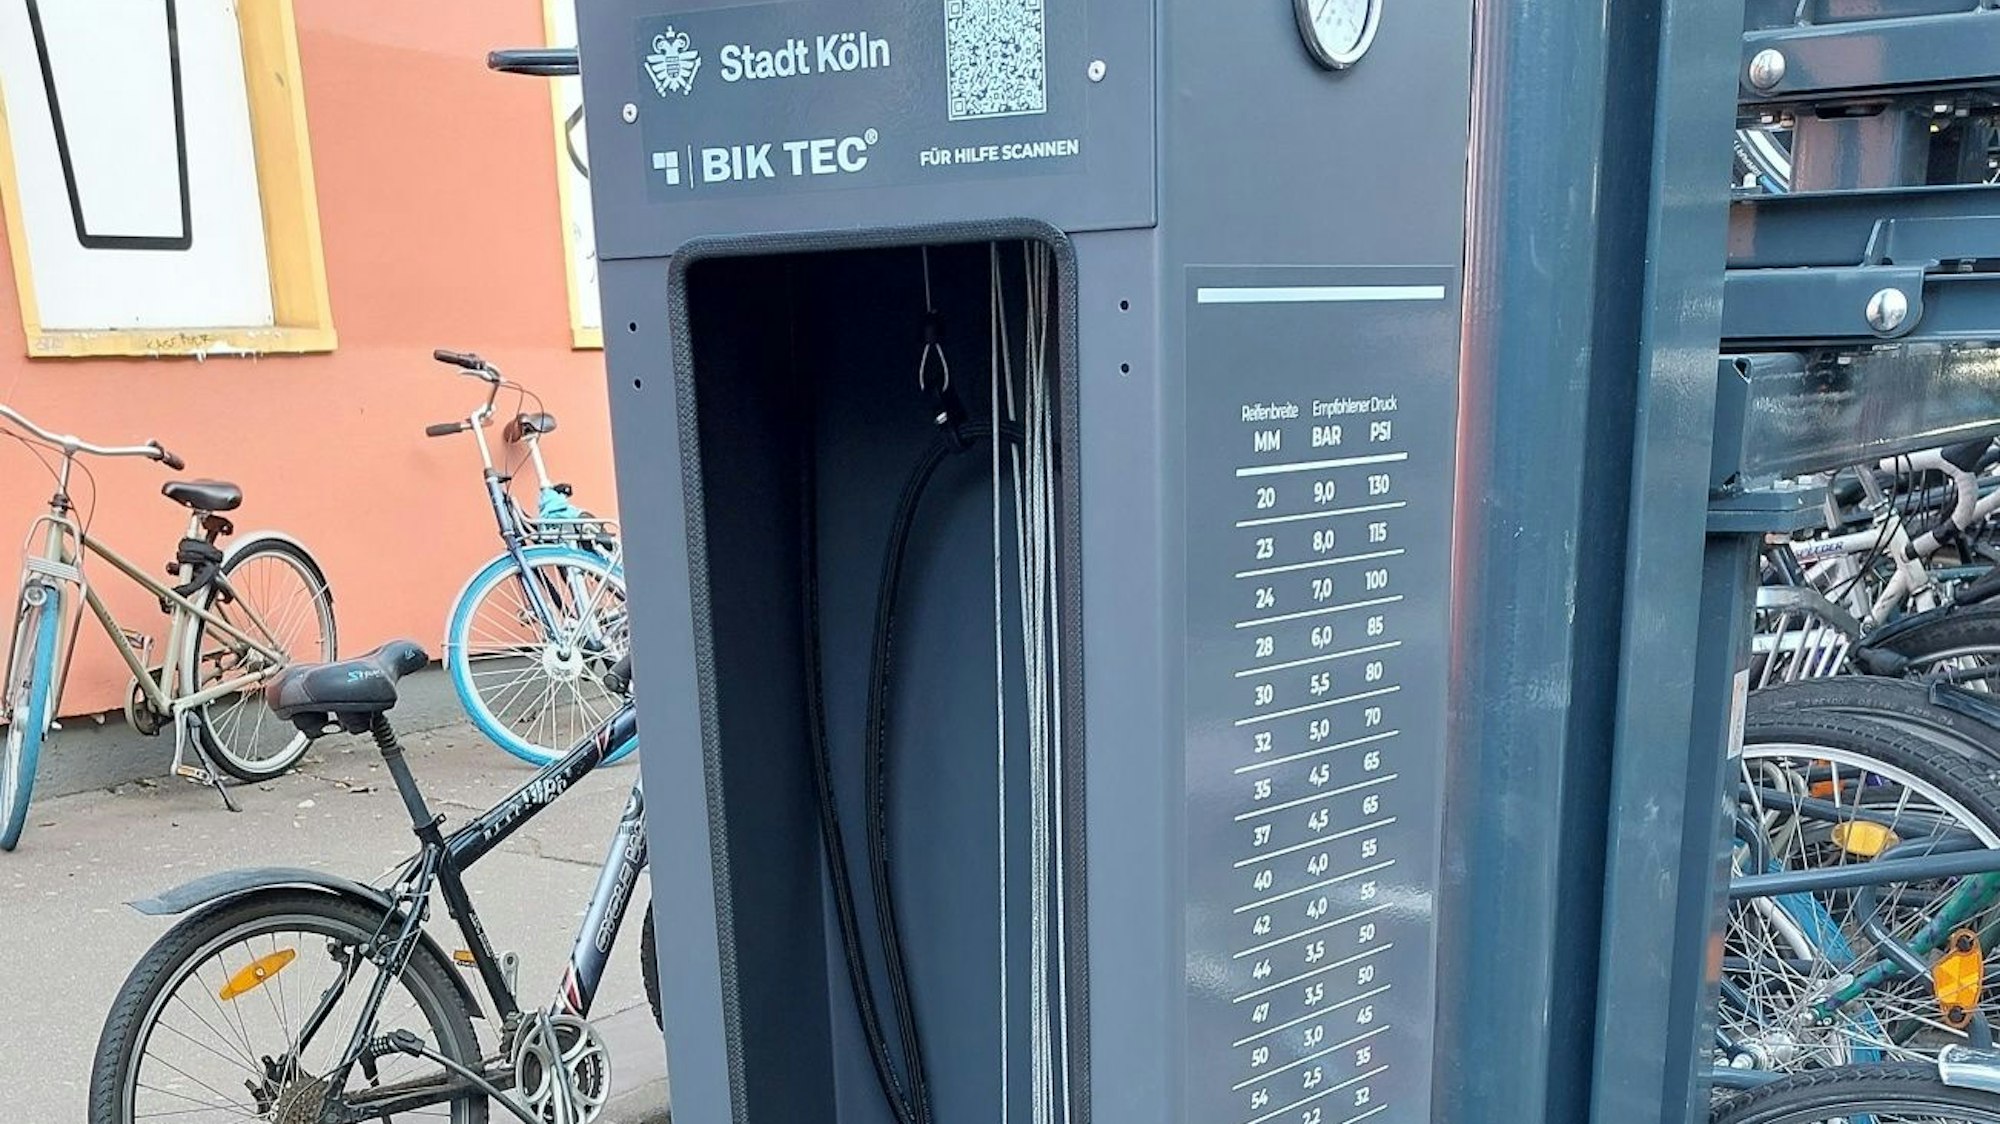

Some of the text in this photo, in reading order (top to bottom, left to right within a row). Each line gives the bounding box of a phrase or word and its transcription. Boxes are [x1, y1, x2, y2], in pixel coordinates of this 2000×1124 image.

[720, 31, 890, 82] Stadt Köln
[701, 143, 776, 183] BIK
[919, 138, 1079, 167] FÜR HILFE SCANNEN
[1241, 393, 1398, 422] Reifenbreite Empfohlener Druck
[1254, 420, 1392, 453] MM BAR PSI
[1256, 473, 1390, 509] 20 9,0 130
[1255, 521, 1388, 560] 23 8,0 115
[1255, 568, 1388, 609] 24 7,0 100
[1255, 615, 1384, 658] 28 6,0 85
[1254, 661, 1383, 706] 30 5,5 80
[1254, 706, 1382, 753] 32 5,0 70
[1254, 750, 1380, 800] 35 4,5 65
[1253, 794, 1379, 847] 37 4,5 65
[1253, 837, 1377, 892] 40 4,0 55
[1252, 881, 1377, 936] 42 4,0 55
[1252, 923, 1376, 980] 44 3,5 50
[1251, 964, 1374, 1024] 47 3,5 50
[1251, 1005, 1373, 1068] 50 3,0 45
[1251, 1045, 1371, 1110] 54 2,5 35
[1354, 1086, 1371, 1107] 32
